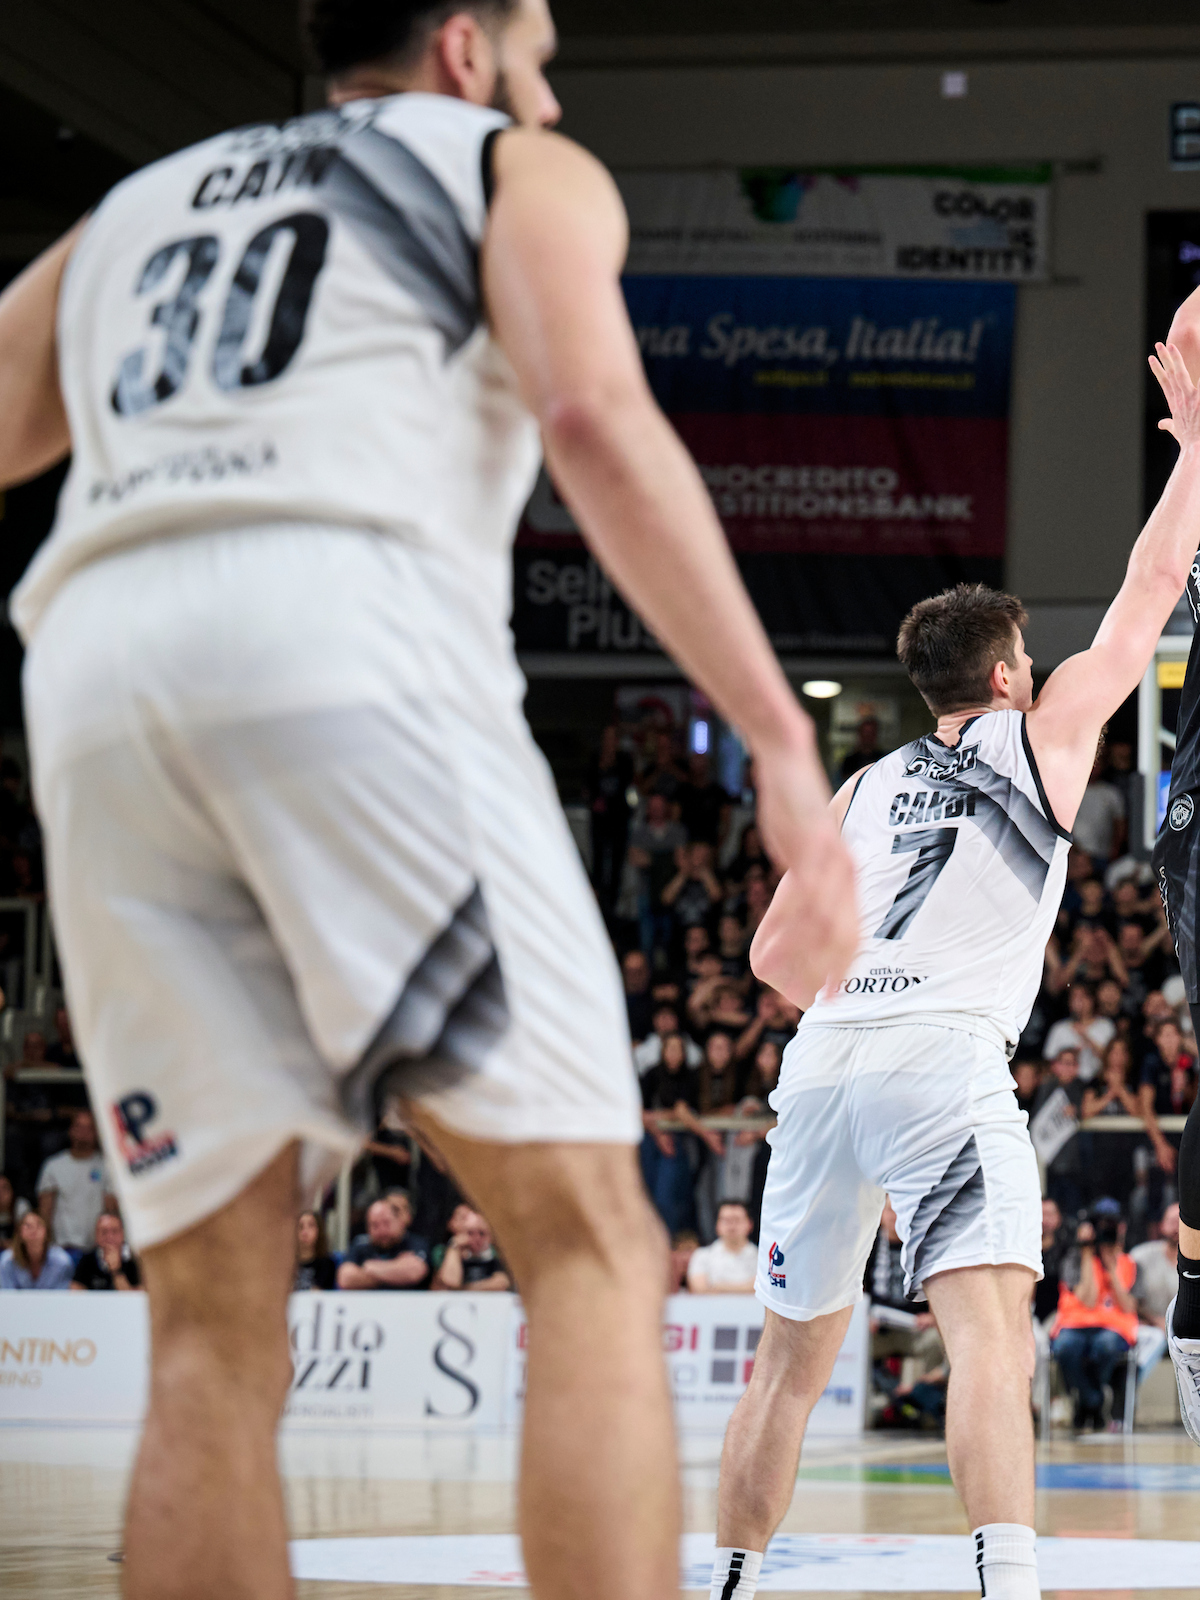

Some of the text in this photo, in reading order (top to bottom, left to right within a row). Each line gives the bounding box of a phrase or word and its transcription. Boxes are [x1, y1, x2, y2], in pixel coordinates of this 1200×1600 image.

[934, 191, 1035, 223] COLOR
[896, 245, 1036, 274] IDENTITY
[111, 211, 330, 417] 30
[700, 313, 840, 366] Spesa,
[845, 315, 985, 362] Italia!
[888, 788, 976, 827] CANDI
[872, 827, 959, 941] 7
[869, 966, 892, 976] CITTÀ
